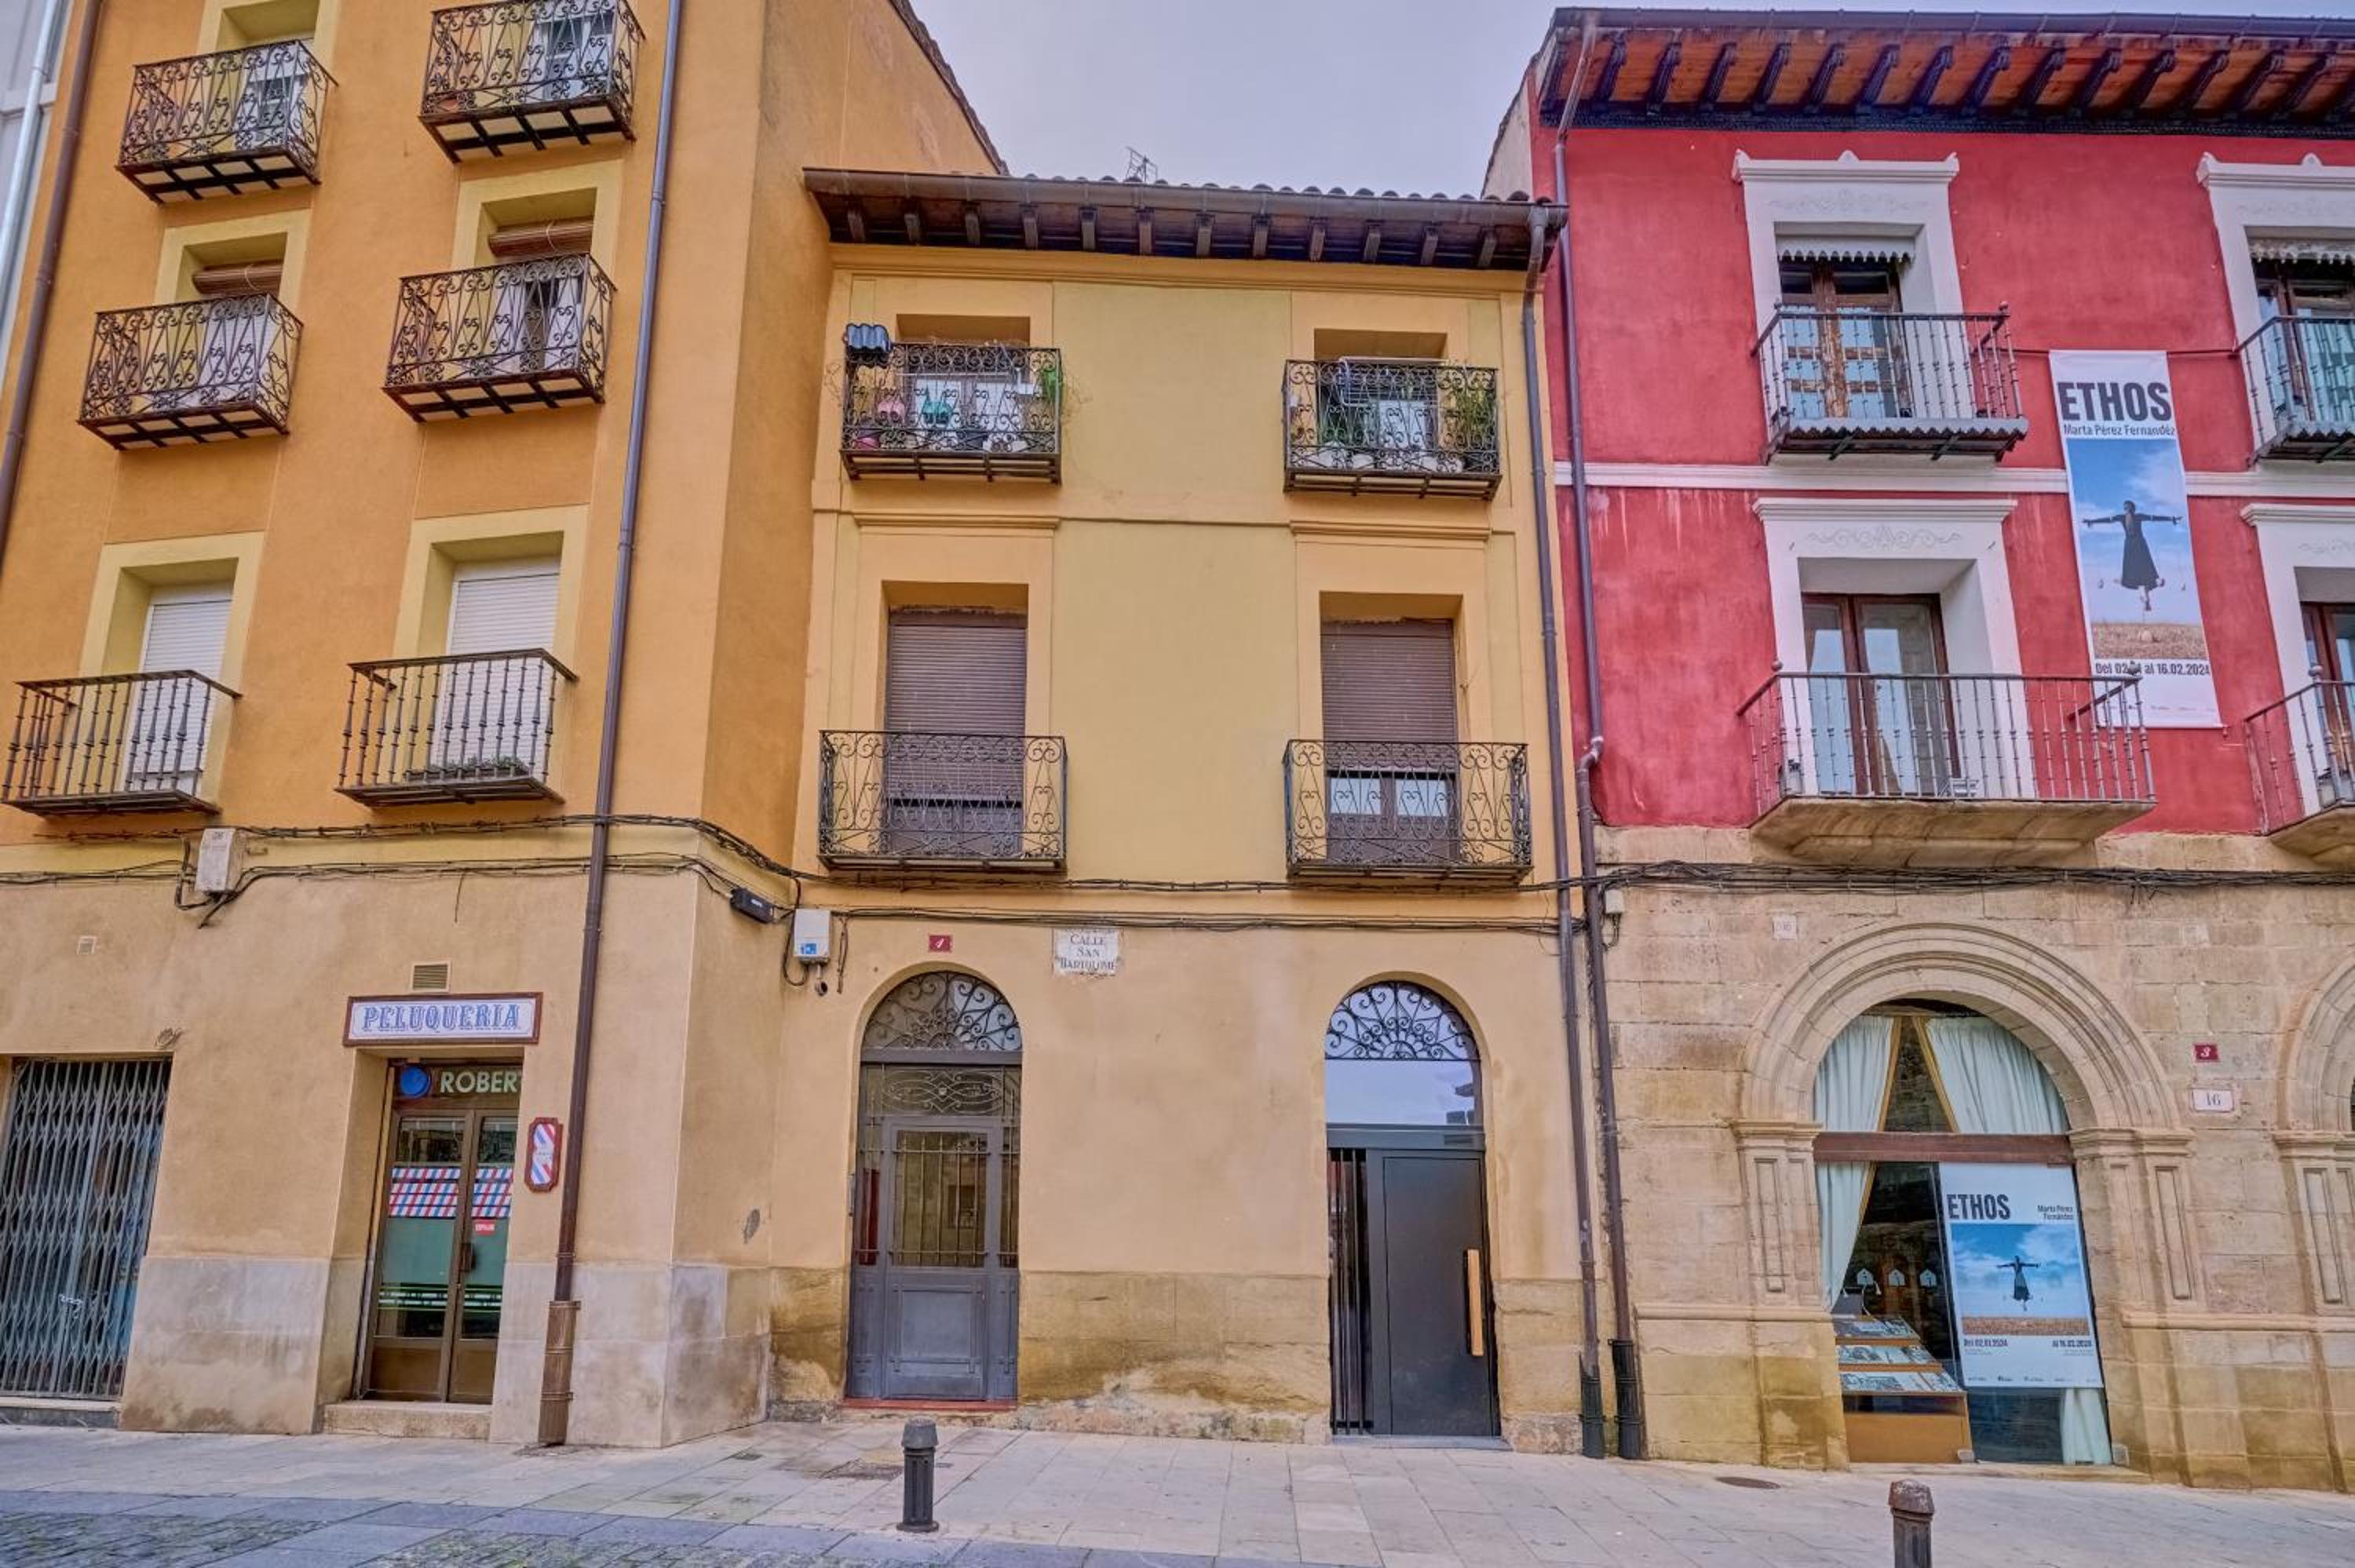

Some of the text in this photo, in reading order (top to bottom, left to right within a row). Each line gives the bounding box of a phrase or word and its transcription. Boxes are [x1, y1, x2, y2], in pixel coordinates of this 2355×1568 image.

[2056, 381, 2172, 422] ETHOS
[2064, 424, 2093, 436] Marta
[2094, 663, 2113, 675] Del
[2144, 663, 2155, 675] al
[440, 1070, 523, 1094] ROBER
[1947, 1194, 2010, 1220] ETHOS
